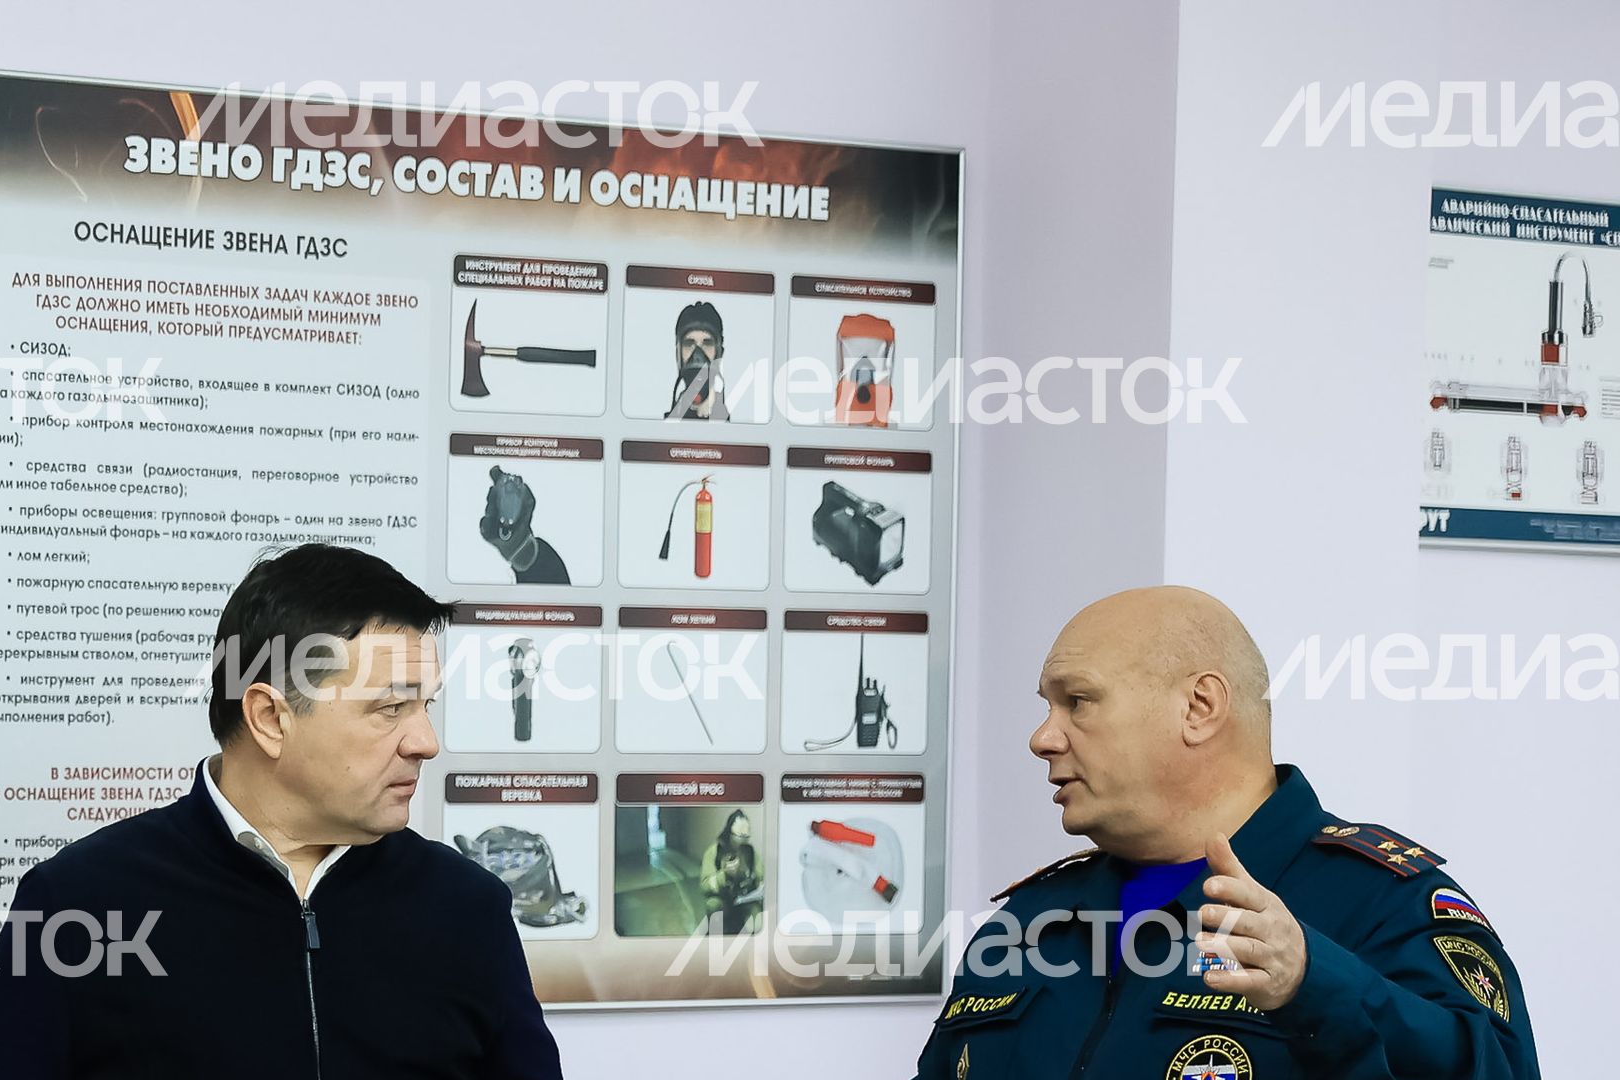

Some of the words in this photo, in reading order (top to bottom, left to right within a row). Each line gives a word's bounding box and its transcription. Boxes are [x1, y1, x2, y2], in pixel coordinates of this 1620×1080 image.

[124, 135, 263, 182] ЗВЕНО
[272, 148, 384, 197] ГДЗС,
[392, 156, 545, 202] СОСТАВ
[553, 166, 582, 204] И
[589, 169, 830, 222] ОСНАЩЕНИЕ
[74, 221, 214, 250] ОСНАЩЕНИЕ
[223, 230, 288, 255] ЗВЕНА
[297, 235, 347, 260] ГДЗС
[12, 272, 40, 288] ДЛЯ
[46, 274, 142, 293] ВЫПОЛНЕНИЯ
[147, 280, 259, 300] ПОСТАВЛЕННЫХ
[264, 287, 308, 304] ЗАДАЧ
[314, 290, 370, 307] КАЖДОЕ
[376, 293, 418, 309] ЗВЕНО
[36, 294, 71, 311] ГДЗС
[76, 296, 141, 313] ДОЛЖНО
[146, 300, 190, 316] ИМЕТЬ
[195, 302, 303, 322] НЕОБХОДИМЫЙ
[308, 309, 381, 326] МИНИМУМ
[56, 315, 152, 336] ОСНАЩЕНИЯ,
[158, 320, 223, 338] КОТОРЫЙ
[229, 324, 361, 345] ПРЕДУСМАТРИВАЕТ:
[20, 341, 71, 358] СИЗОД;
[26, 461, 86, 476] средства
[97, 464, 133, 475] связи
[143, 462, 241, 480] (радиостанция,
[252, 470, 340, 485] переговорное
[350, 473, 418, 487] устройство
[17, 552, 41, 562] лом
[44, 551, 91, 564] легкий;
[16, 578, 85, 593] пожарную
[87, 579, 179, 594] спасательную
[67, 710, 114, 727] работ).
[51, 767, 59, 781] В
[64, 767, 173, 781] ЗАВИСИМОСТИ
[1162, 991, 1233, 1011] БЕЛЯЕВ
[1172, 1045, 1197, 1072] МЧС
[1204, 1038, 1249, 1074] РОССИИ
